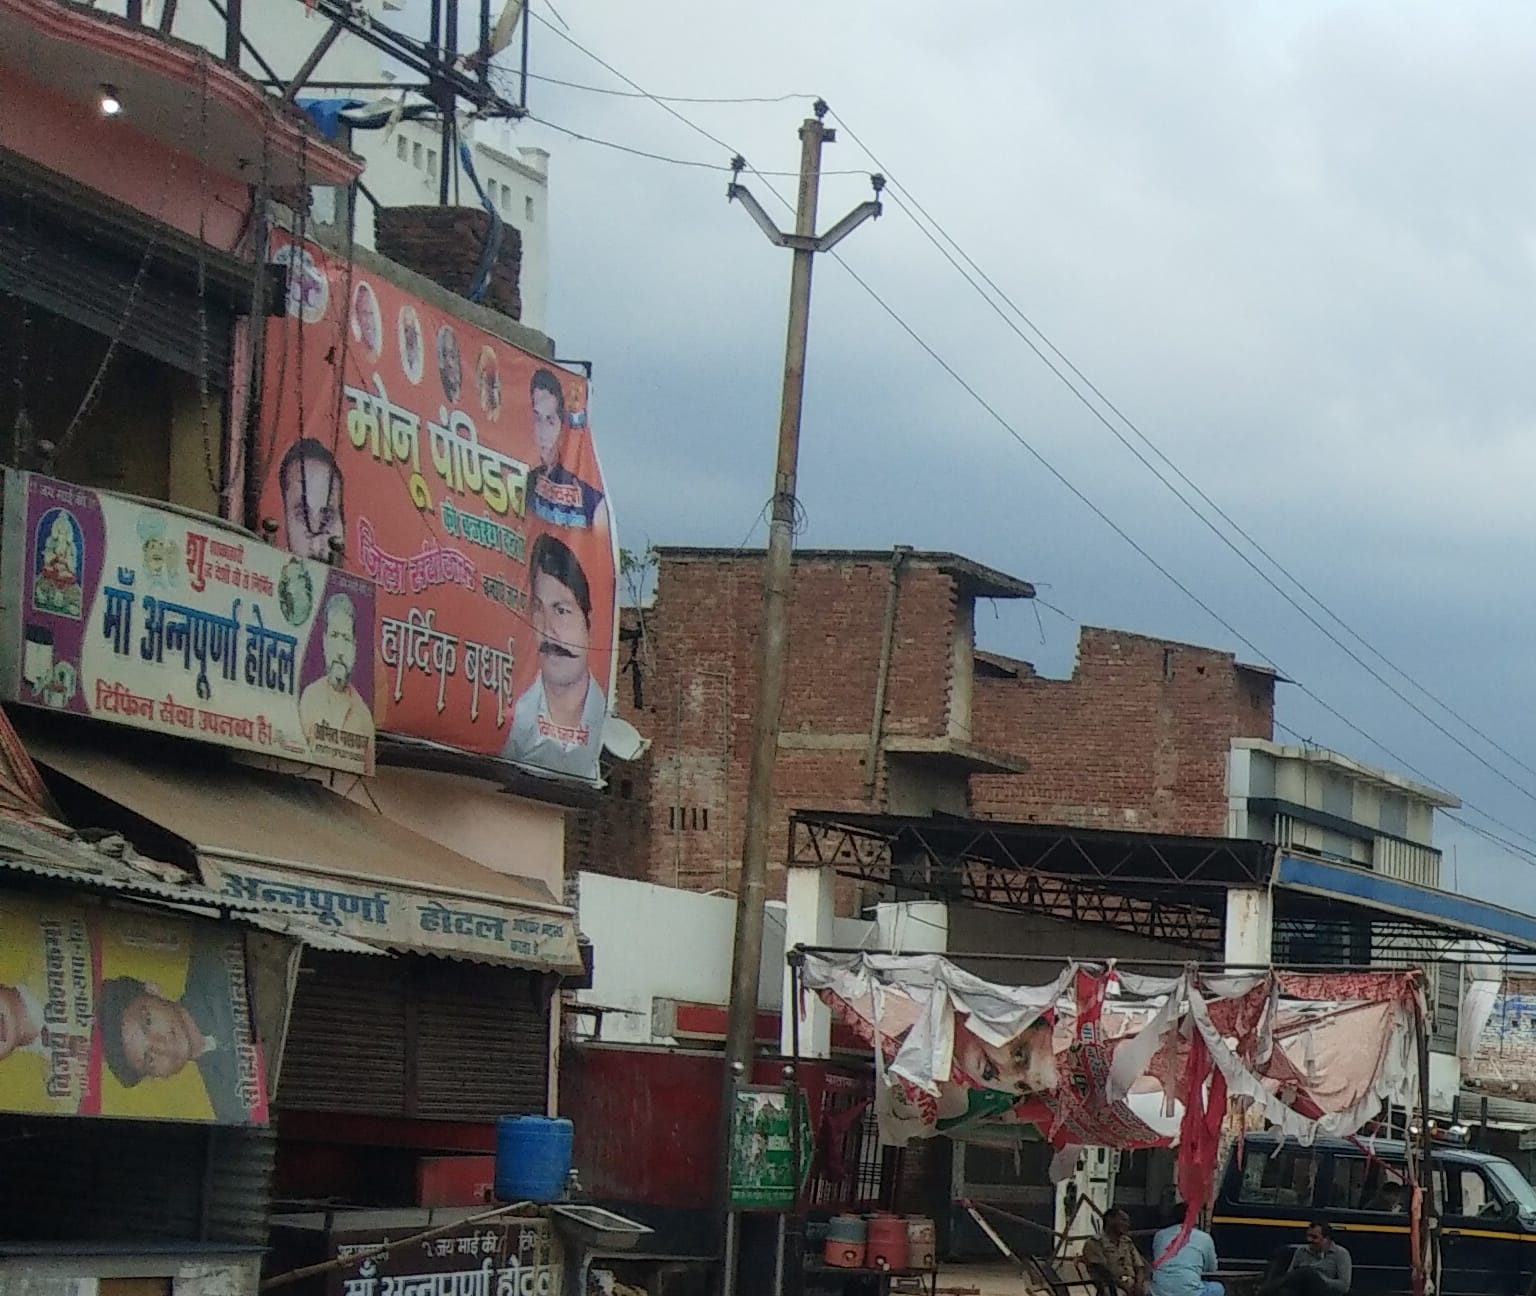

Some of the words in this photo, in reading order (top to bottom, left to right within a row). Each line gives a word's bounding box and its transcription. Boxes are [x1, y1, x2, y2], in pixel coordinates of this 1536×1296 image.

[344, 372, 433, 514] मोनू
[103, 566, 136, 656] माँ
[140, 596, 242, 701] अन्नपूर्णा
[244, 603, 298, 696] होटल
[381, 607, 459, 714] हार्दिक
[464, 634, 517, 729] बधाई
[159, 693, 195, 729] सेवा
[221, 871, 390, 928] अन्नपूर्णा
[417, 902, 509, 942] होटल
